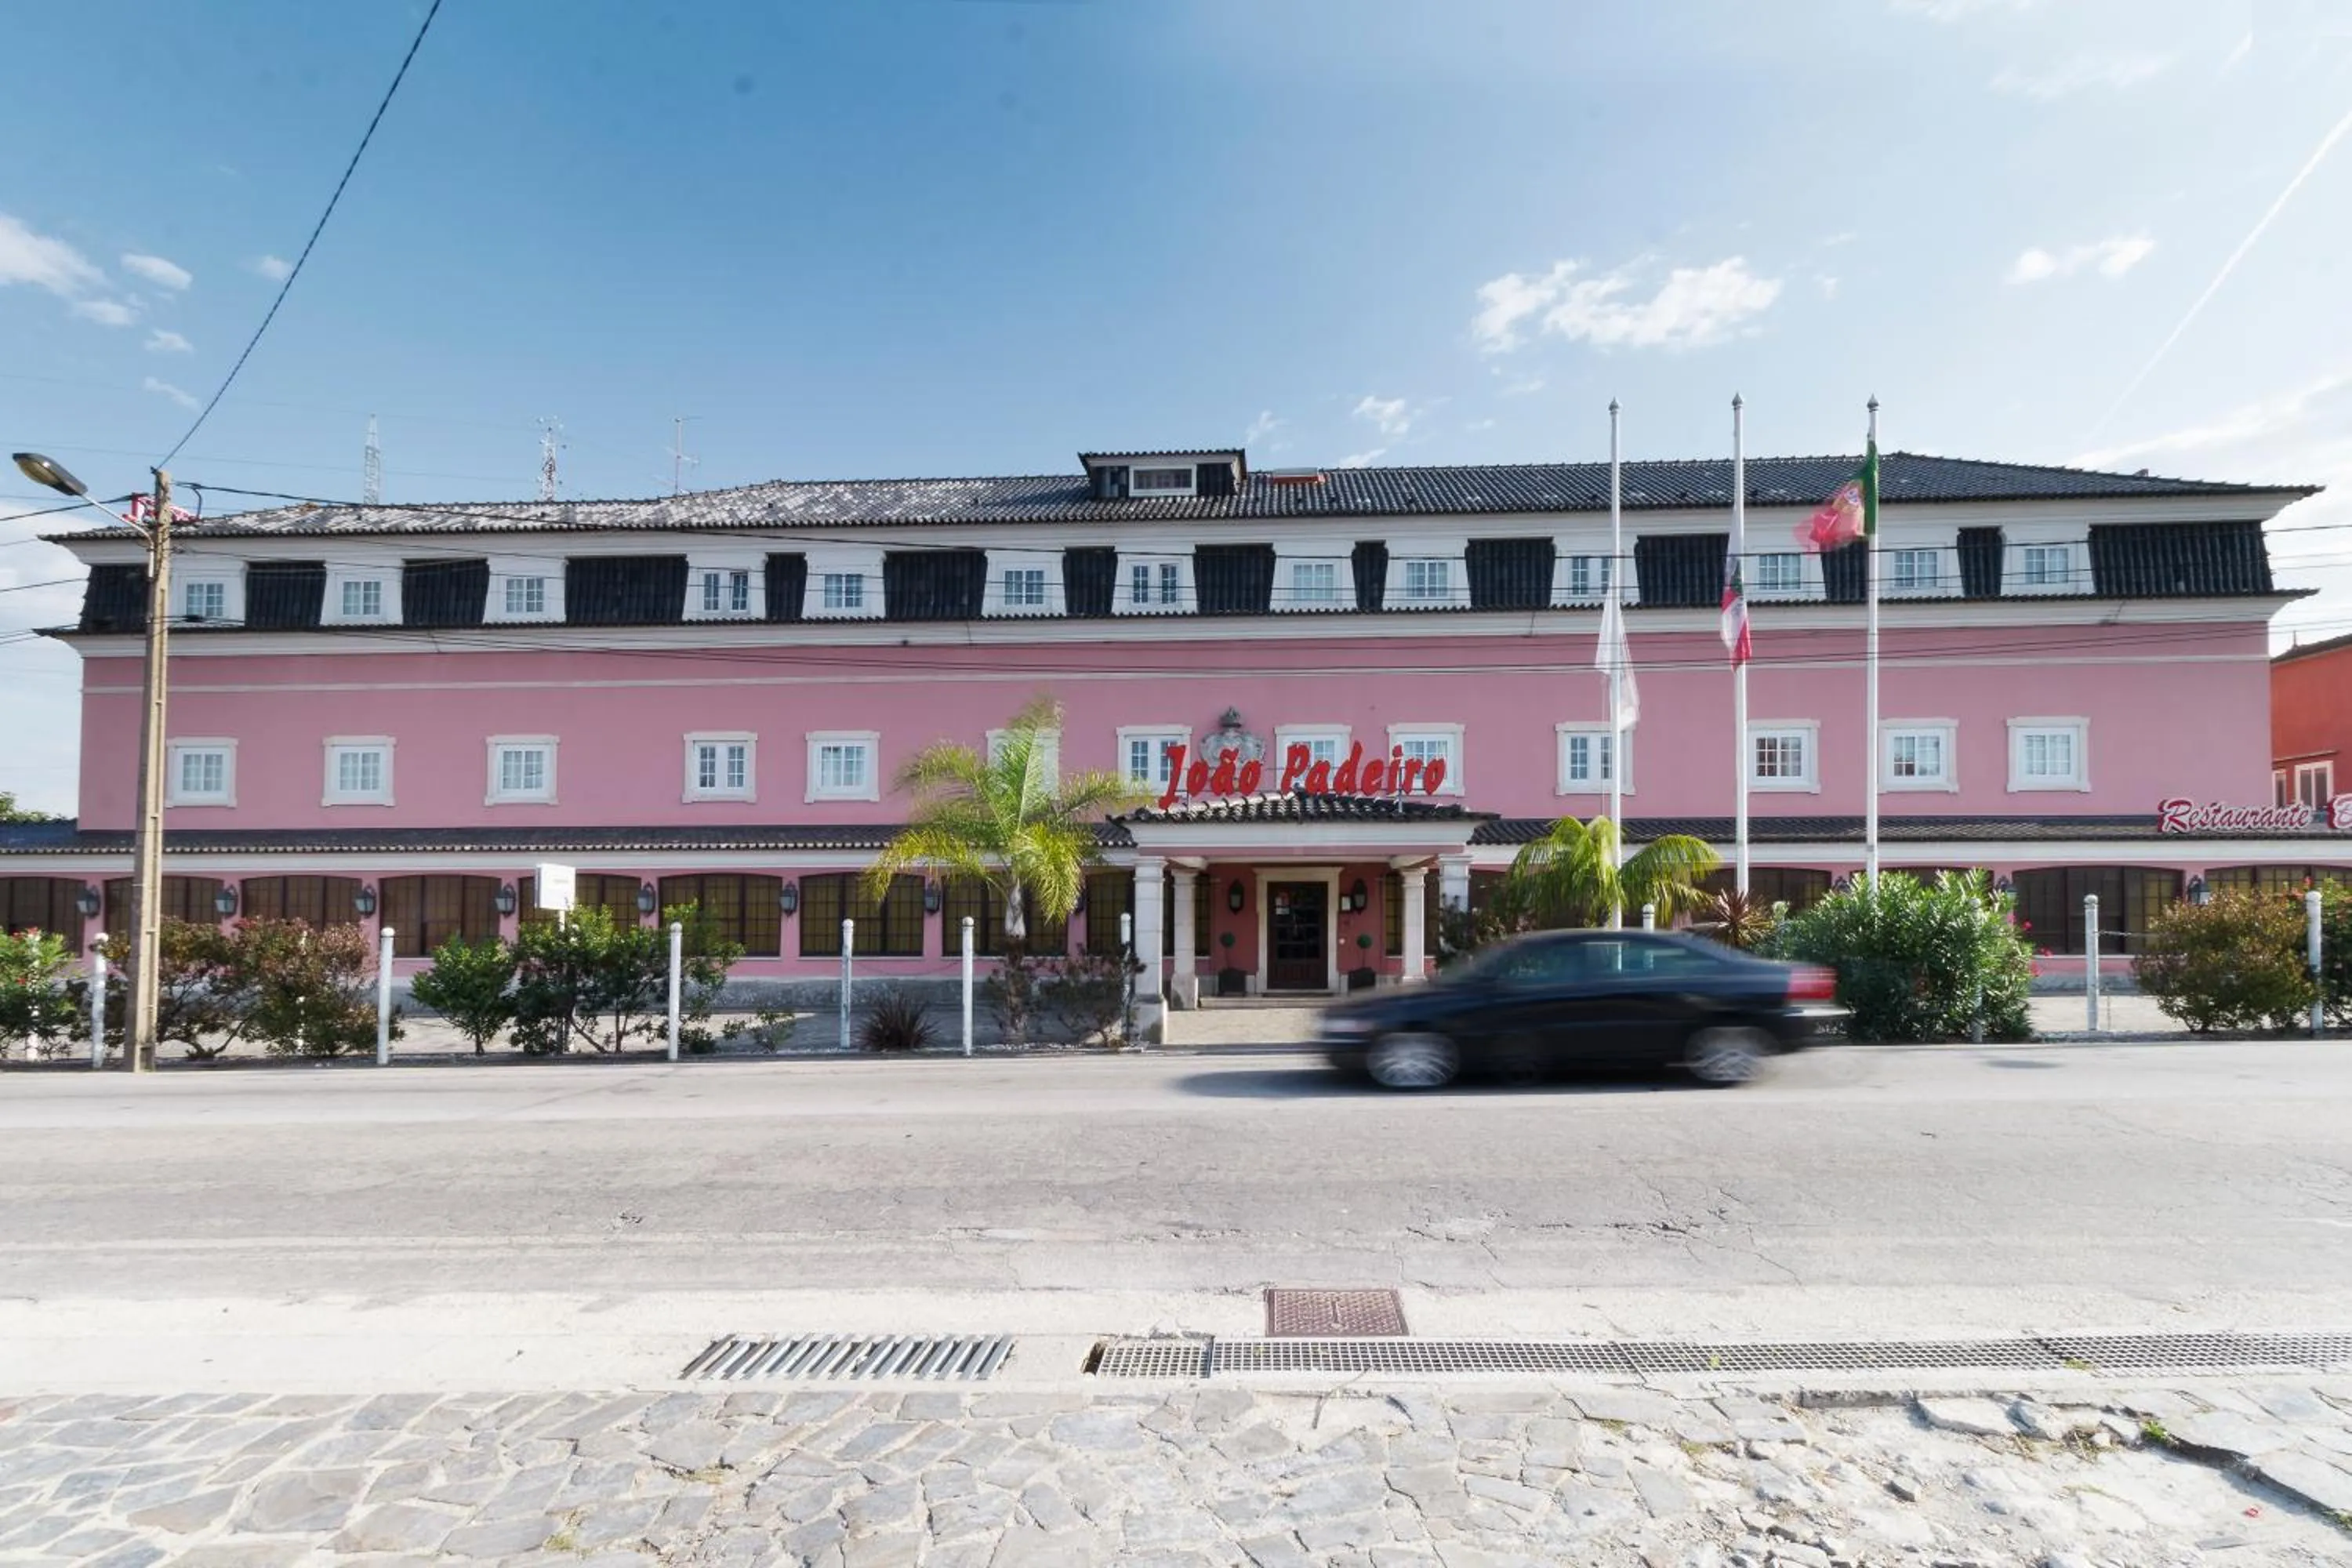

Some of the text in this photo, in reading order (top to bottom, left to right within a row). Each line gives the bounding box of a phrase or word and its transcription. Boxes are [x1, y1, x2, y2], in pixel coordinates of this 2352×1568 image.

[1158, 740, 1446, 809] João Padeiro
[2158, 798, 2310, 832] Restaurante
